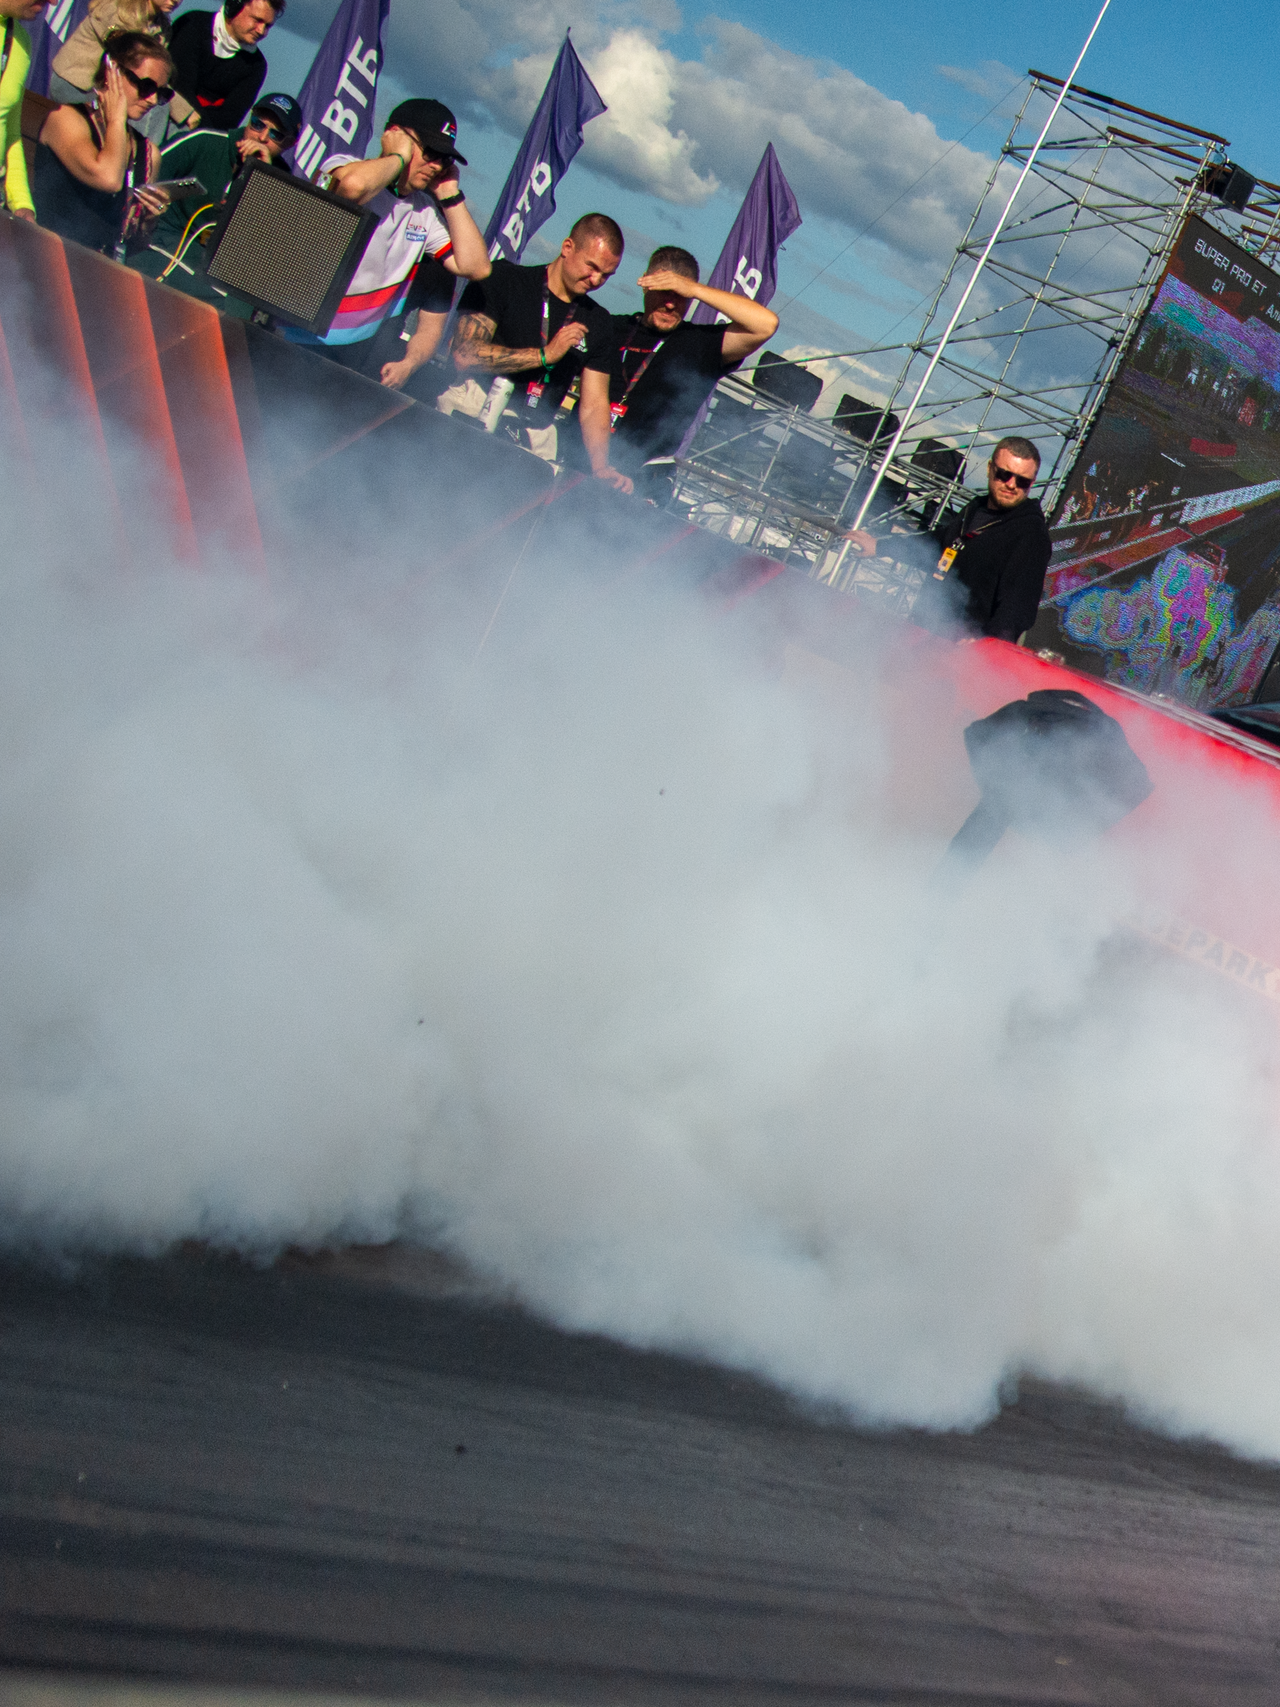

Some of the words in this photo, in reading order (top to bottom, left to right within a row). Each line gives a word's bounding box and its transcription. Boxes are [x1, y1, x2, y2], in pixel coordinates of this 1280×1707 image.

[321, 35, 378, 145] ВТБ
[1194, 238, 1230, 272] SUPER
[1229, 264, 1252, 287] PRO
[1251, 279, 1267, 296] ET
